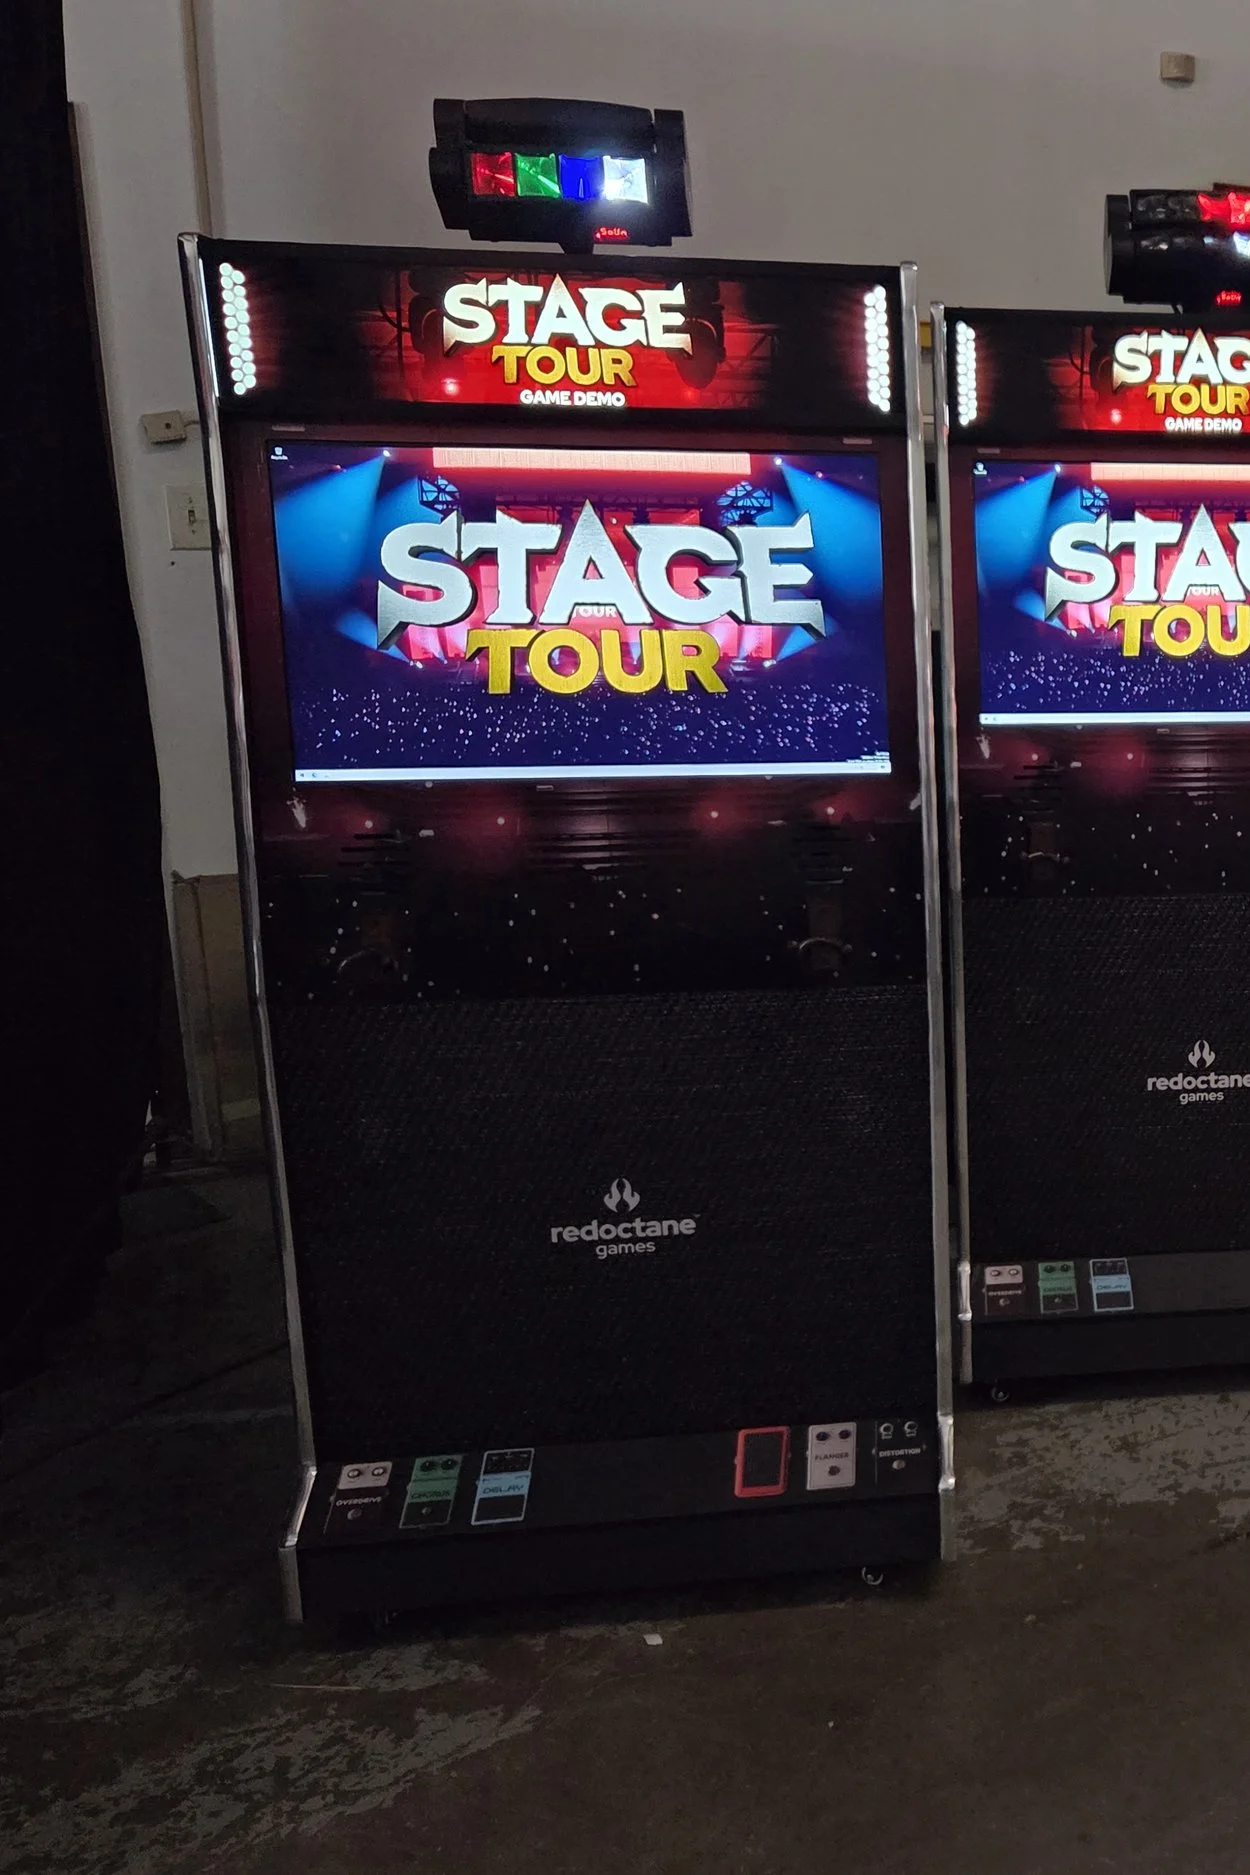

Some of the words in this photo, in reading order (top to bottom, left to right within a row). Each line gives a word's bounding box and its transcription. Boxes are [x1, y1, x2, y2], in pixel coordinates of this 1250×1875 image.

[443, 273, 692, 356] STAGE
[492, 345, 636, 387] TOUR
[519, 389, 571, 406] GAME
[573, 391, 626, 407] DEMO
[1147, 384, 1250, 415] TOUR
[1164, 416, 1203, 432] GAME
[1204, 417, 1242, 432] DEMO
[377, 499, 826, 650] STAGE
[465, 628, 728, 695] TOUR
[1179, 1091, 1224, 1105] games
[550, 1217, 697, 1243] redoctane
[595, 1241, 656, 1260] games
